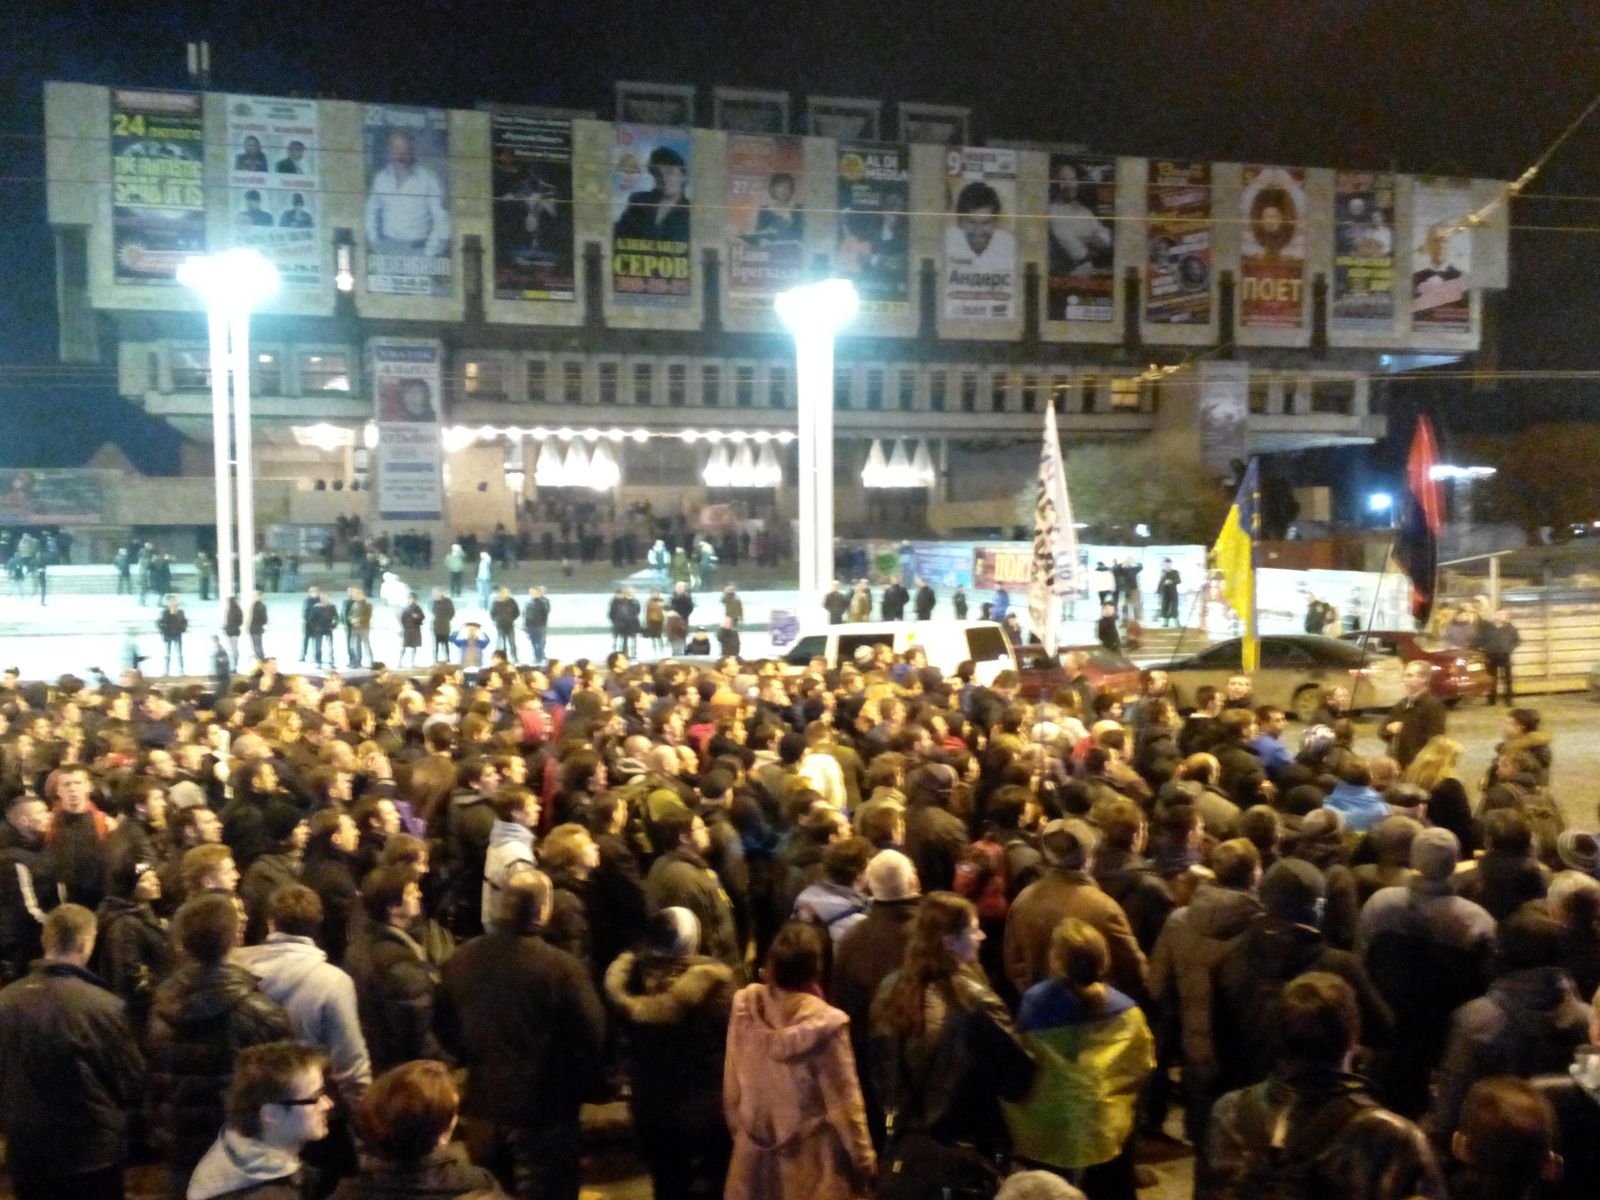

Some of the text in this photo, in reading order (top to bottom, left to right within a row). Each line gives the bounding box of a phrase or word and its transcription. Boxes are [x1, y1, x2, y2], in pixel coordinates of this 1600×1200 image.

[113, 113, 146, 137] 24
[612, 253, 689, 279] СЕРОВ
[949, 269, 1012, 293] Андерс
[1241, 276, 1302, 301] ПОЕТ
